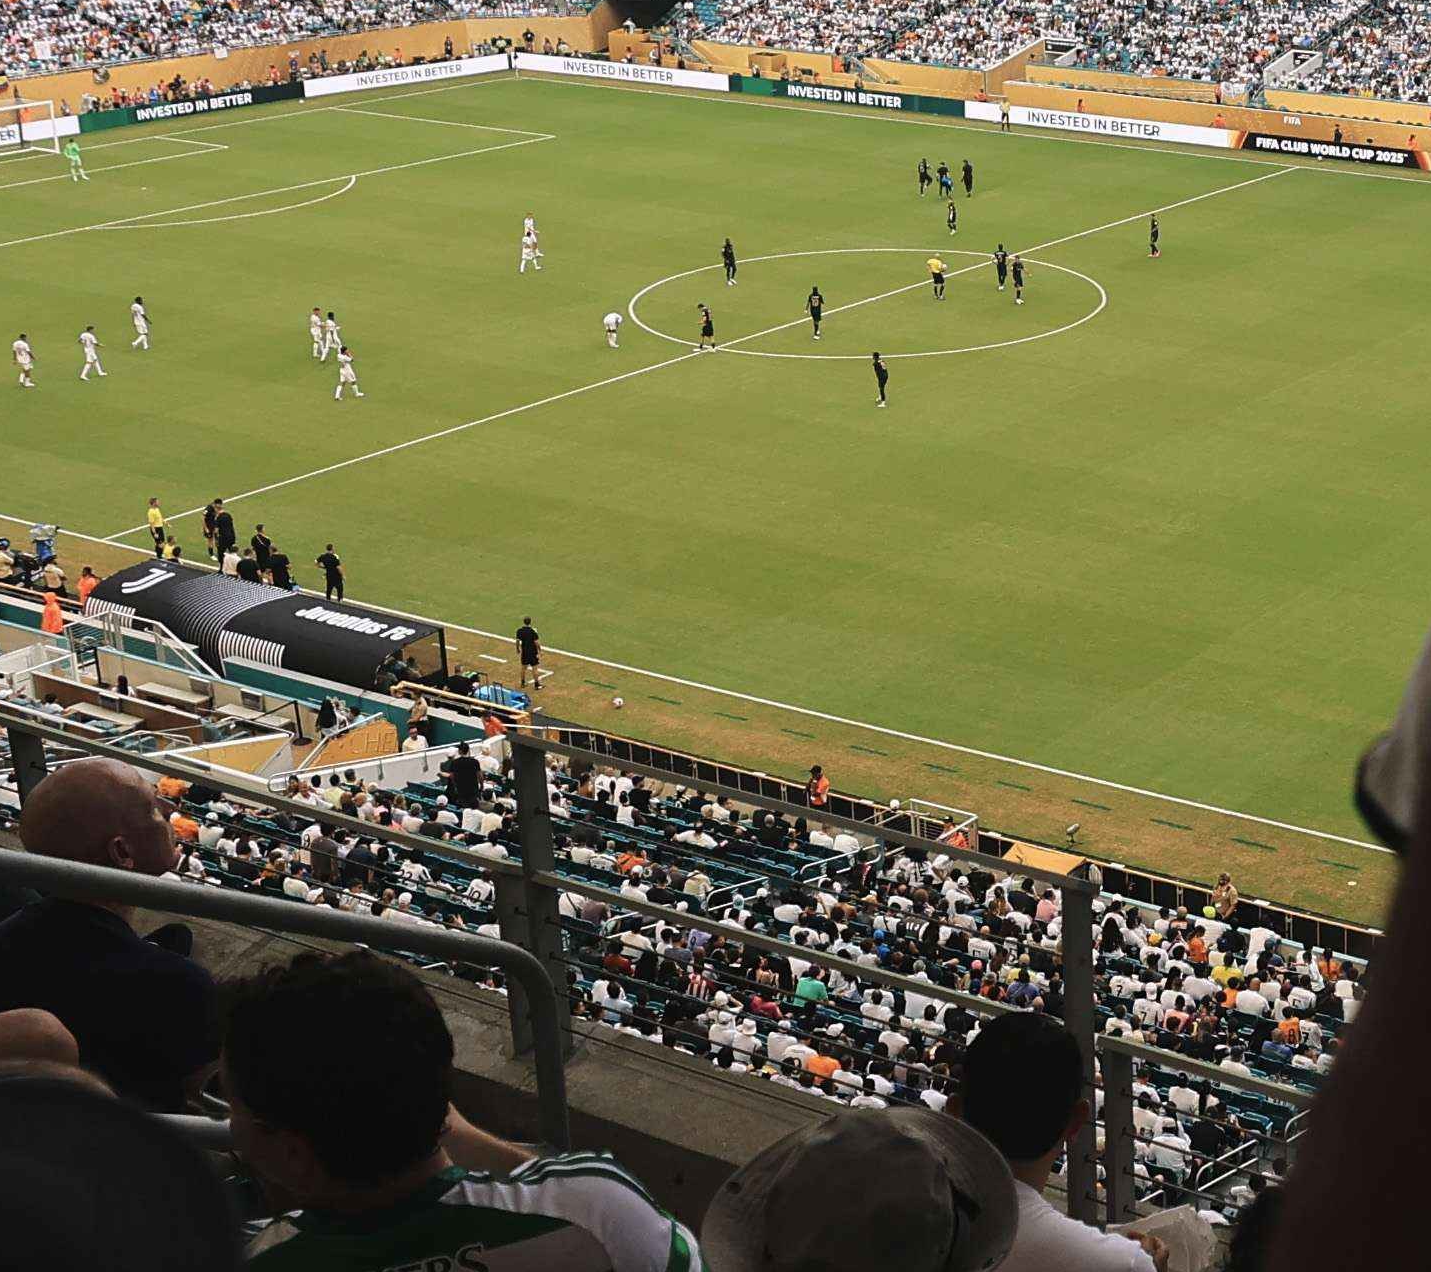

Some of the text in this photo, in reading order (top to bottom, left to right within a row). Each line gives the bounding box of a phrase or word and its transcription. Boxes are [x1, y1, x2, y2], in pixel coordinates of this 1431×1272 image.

[563, 60, 673, 82] INVESTED IN BETTER
[136, 92, 252, 121] INVESTED IN BETTER
[787, 84, 902, 108] INVESTED IN BETTER
[1283, 116, 1302, 126] FIFA
[1256, 137, 1279, 150] FIFA
[1280, 140, 1309, 153] CLUB
[1310, 144, 1350, 158] WORLD
[1351, 148, 1375, 160] CUP
[295, 606, 415, 641] Juventus FC
